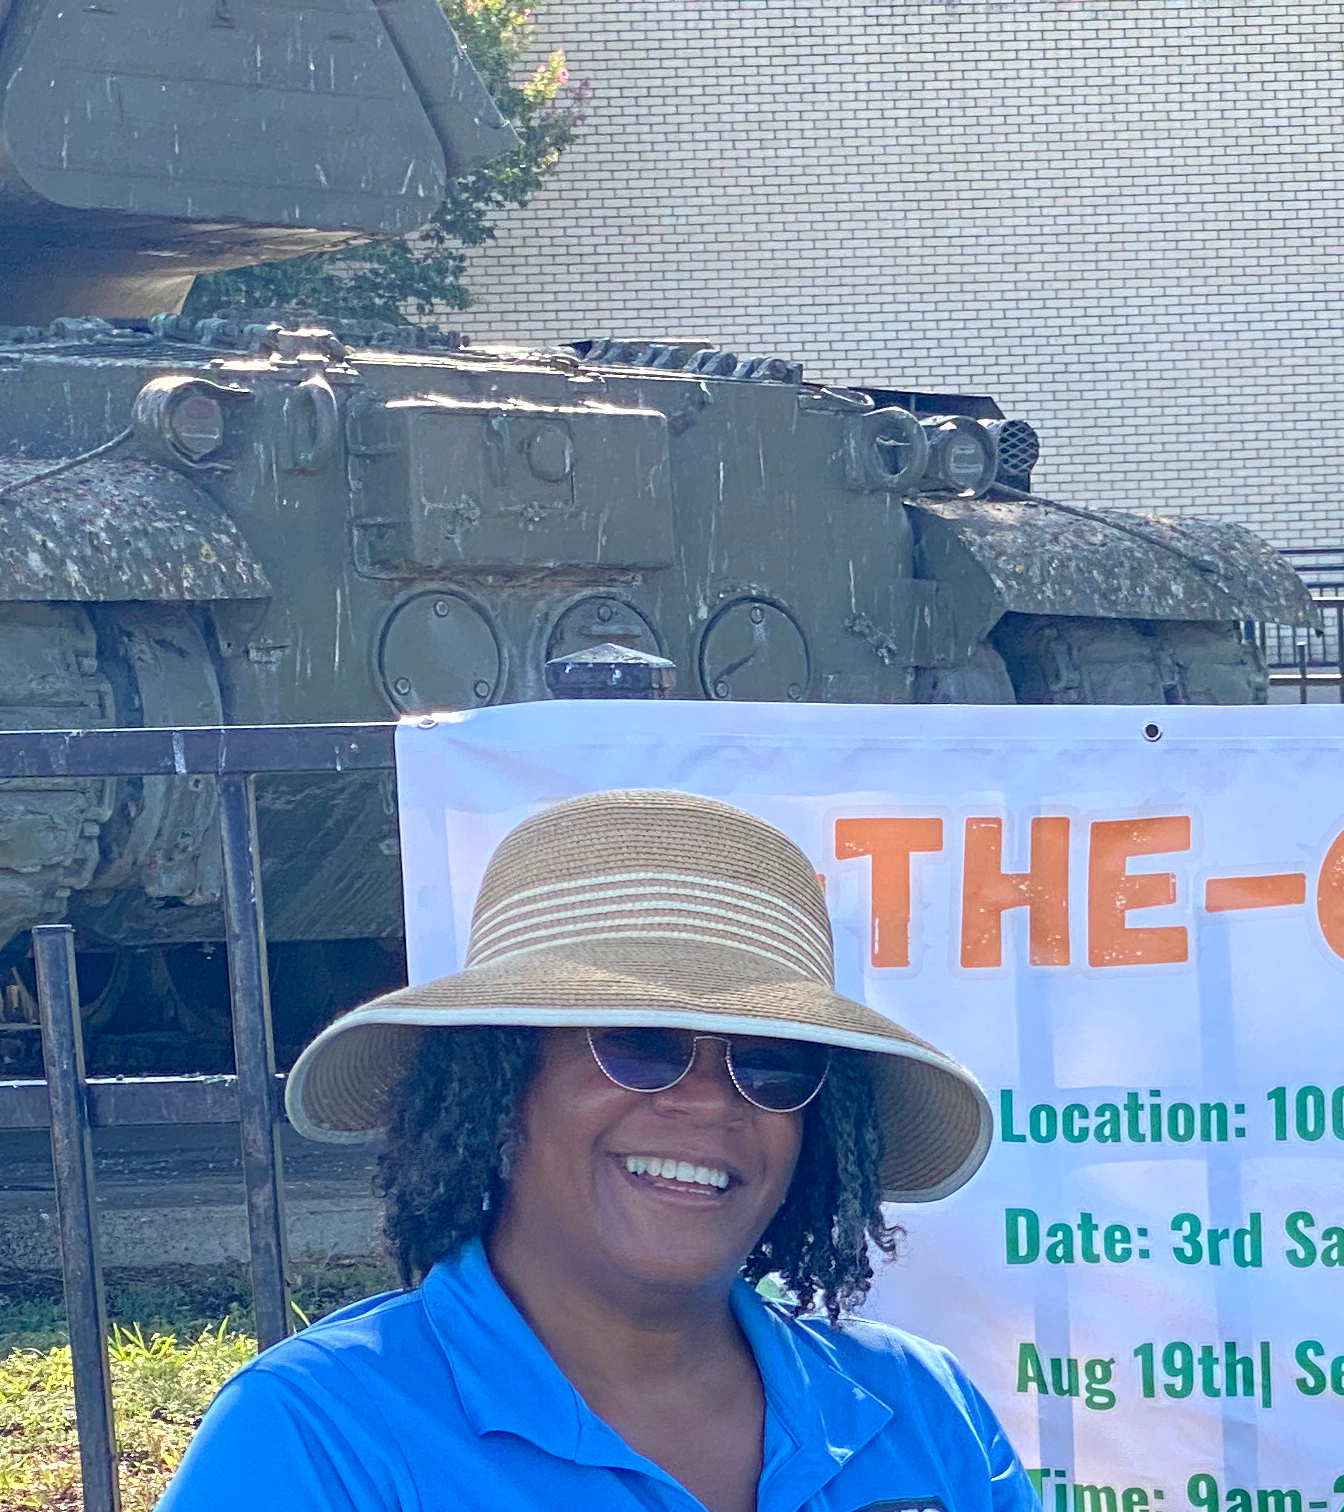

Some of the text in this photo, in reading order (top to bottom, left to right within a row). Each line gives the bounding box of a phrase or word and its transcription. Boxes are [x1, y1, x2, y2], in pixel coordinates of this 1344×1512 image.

[1000, 1088, 1247, 1144] Location:
[1004, 1207, 1150, 1265] Date:
[1170, 1211, 1263, 1268] 3rd
[1016, 1342, 1117, 1411] Aug
